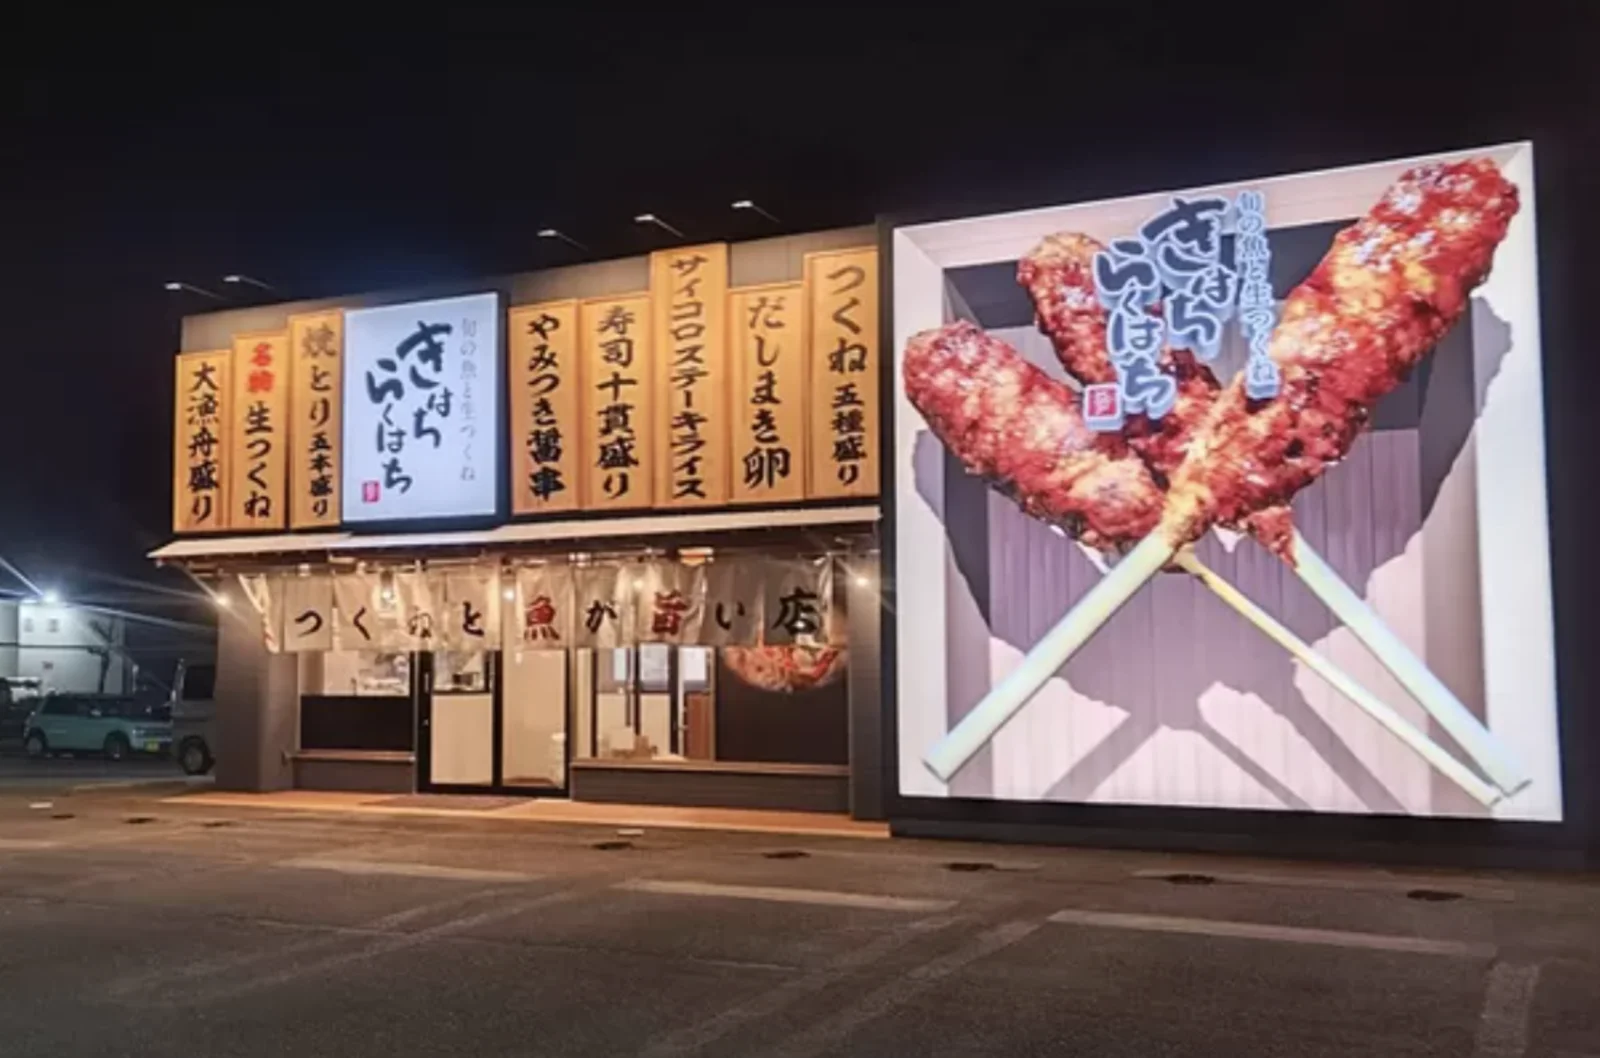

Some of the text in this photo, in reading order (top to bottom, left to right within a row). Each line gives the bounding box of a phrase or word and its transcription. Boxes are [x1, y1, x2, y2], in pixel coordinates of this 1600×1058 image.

[187, 362, 219, 523] 大漁舟盛り
[301, 322, 337, 517] 焼とり五本盛り
[596, 305, 639, 499] 寿司十貫盛り
[670, 255, 708, 499] サイコロステーキライス
[742, 296, 791, 489] だしまき卵
[828, 265, 868, 486] つくね五種盛り
